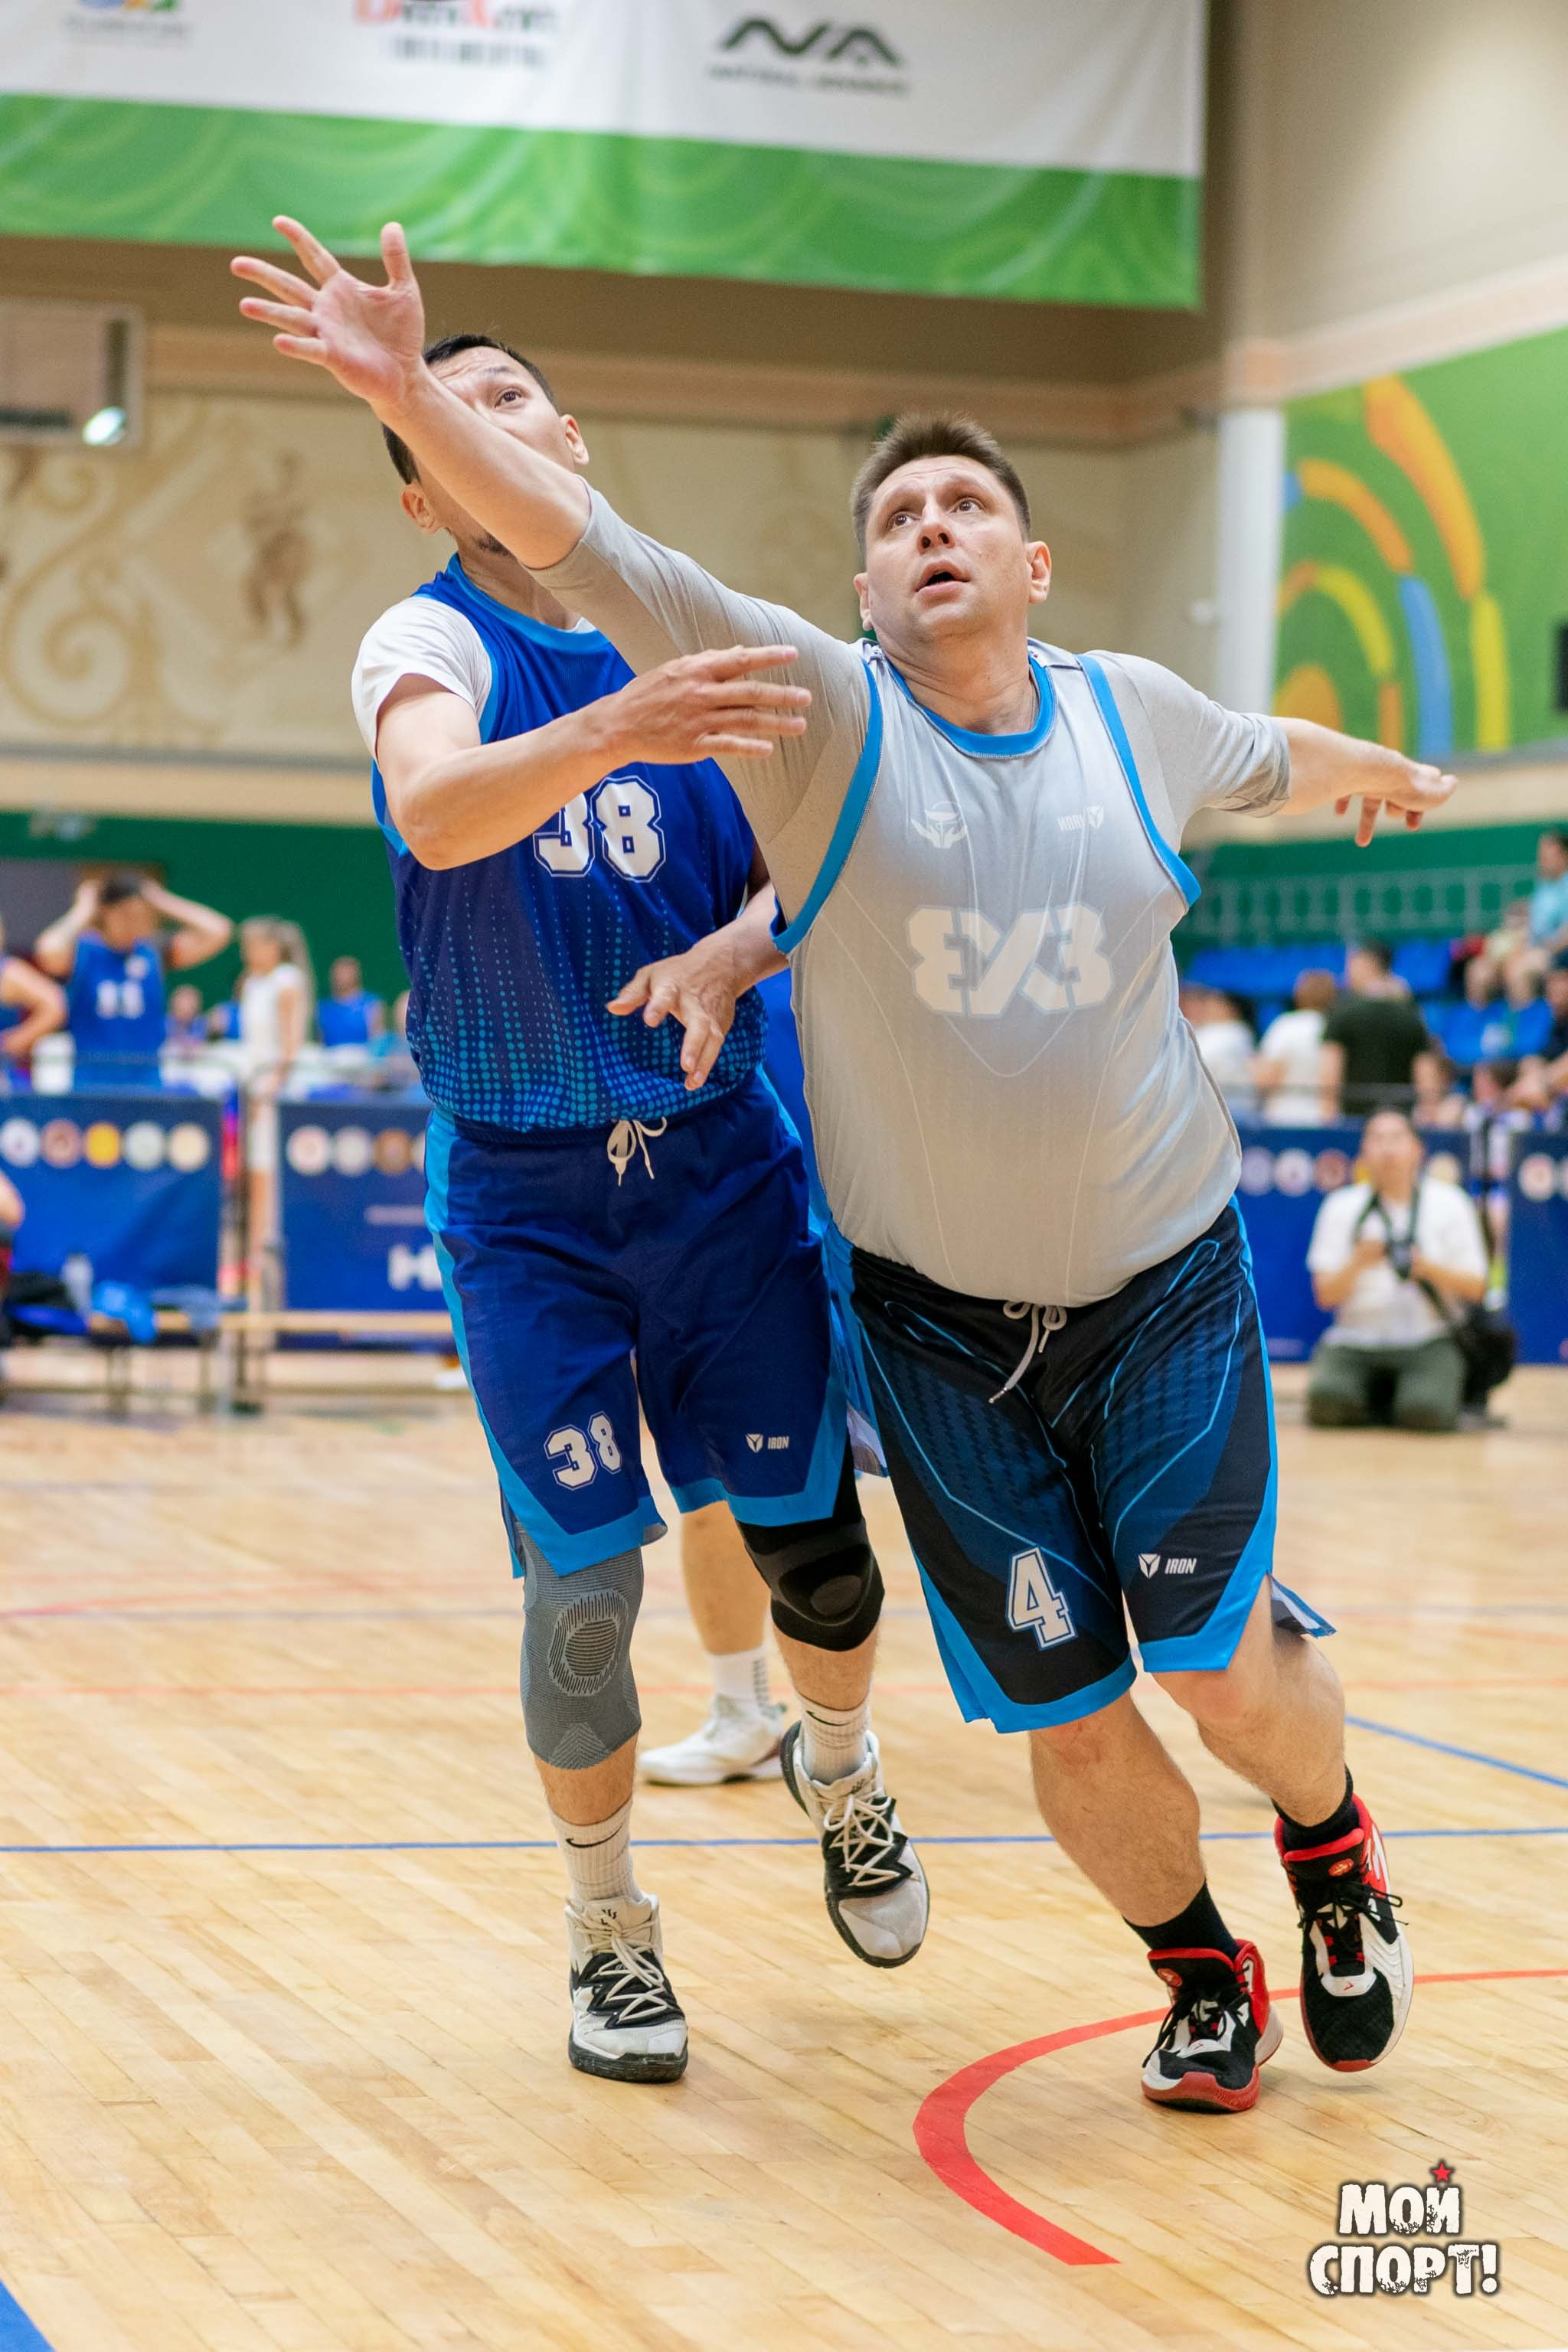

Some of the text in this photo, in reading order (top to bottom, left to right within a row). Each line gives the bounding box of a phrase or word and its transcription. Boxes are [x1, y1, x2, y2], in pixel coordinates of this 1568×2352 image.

[534, 776, 665, 883] 38
[543, 1410, 622, 1491] 38
[768, 1436, 789, 1449] IRON
[1006, 1545, 1078, 1651] 4
[1165, 1557, 1197, 1575] IRON
